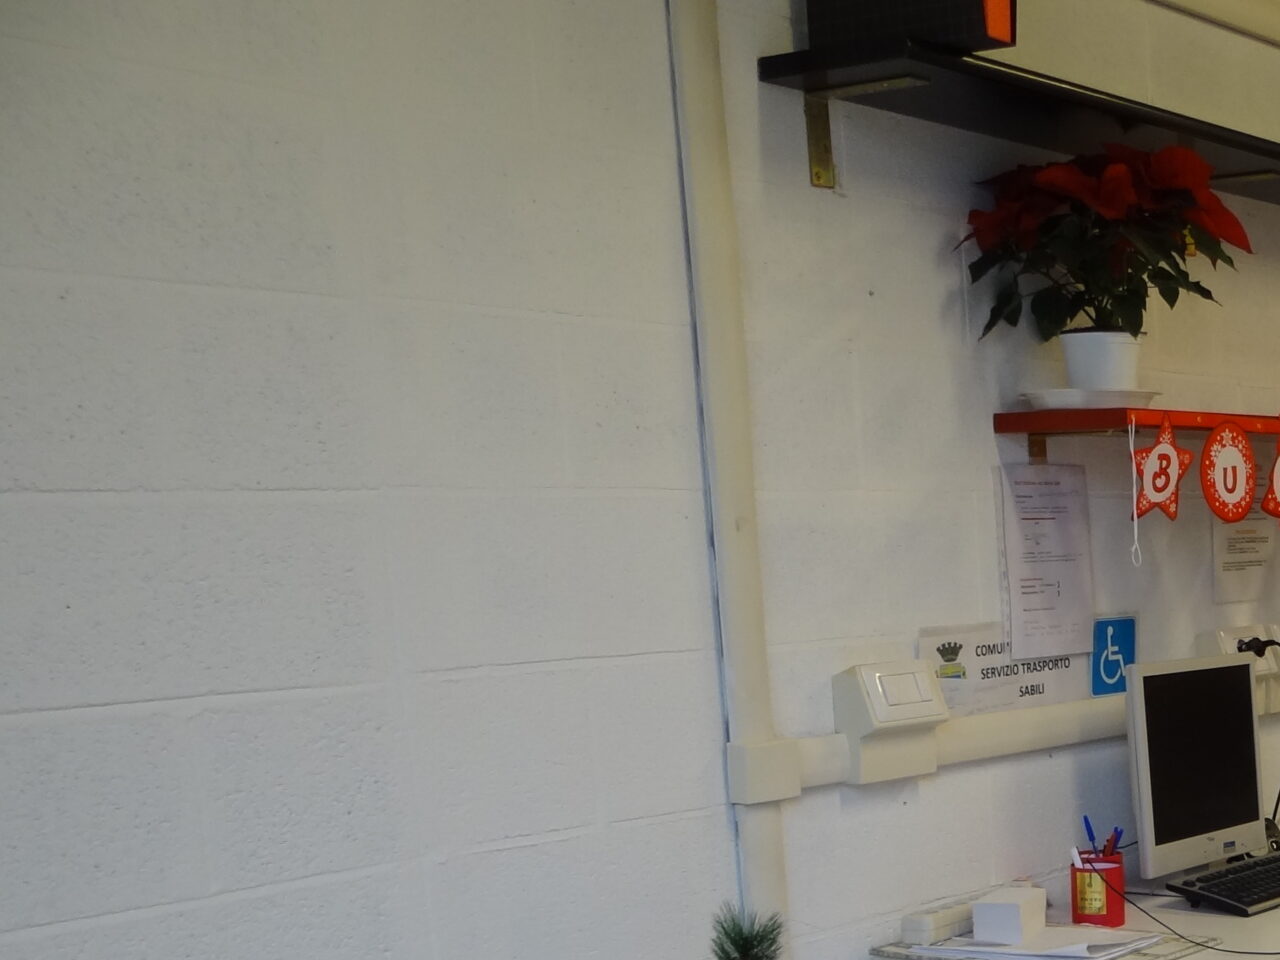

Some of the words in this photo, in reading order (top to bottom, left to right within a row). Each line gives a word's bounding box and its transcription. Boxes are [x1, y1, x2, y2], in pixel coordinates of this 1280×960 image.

[981, 664, 1019, 680] SERVIZIO
[1021, 657, 1071, 675] TRASPORTO
[1019, 683, 1045, 698] SABILI
